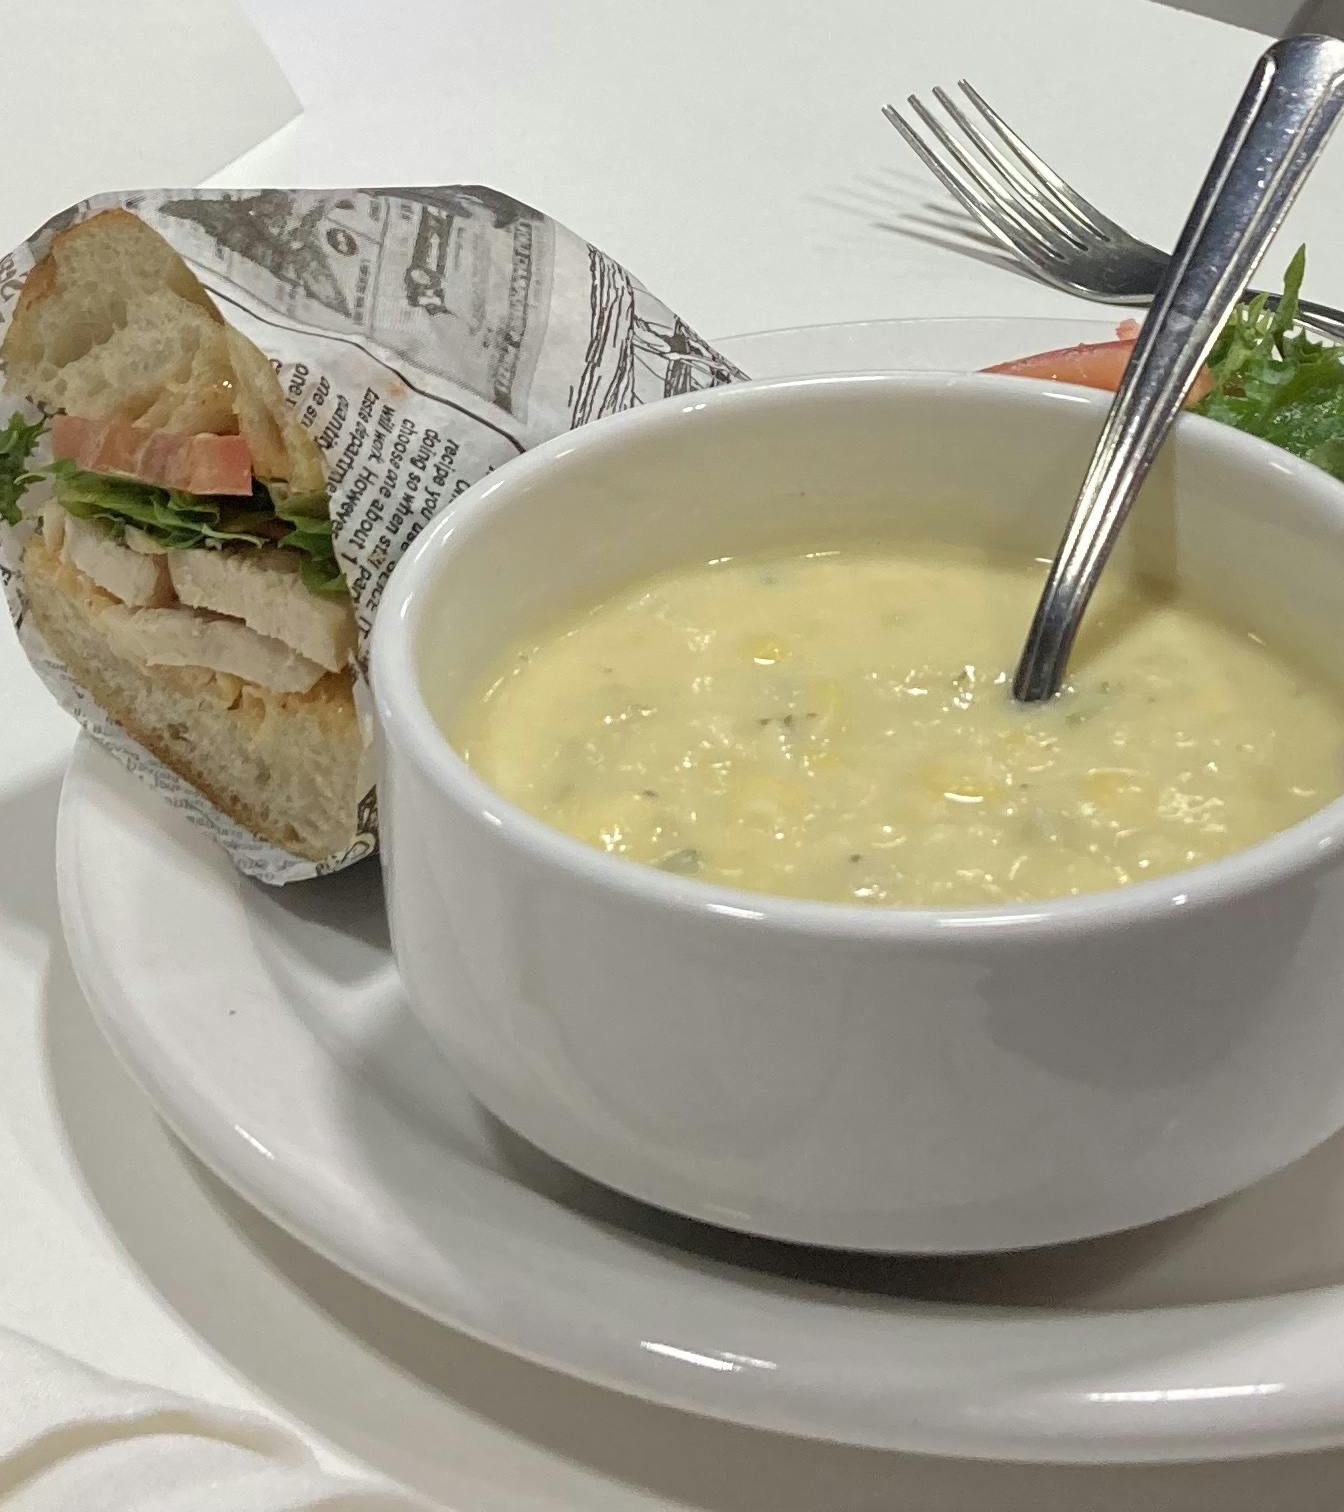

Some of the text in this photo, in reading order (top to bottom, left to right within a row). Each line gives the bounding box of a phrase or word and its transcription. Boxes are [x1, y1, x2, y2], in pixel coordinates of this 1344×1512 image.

[294, 364, 309, 398] one
[358, 387, 379, 424] taste
[378, 404, 395, 430] will
[389, 418, 415, 472] choose
[411, 428, 438, 471] doing
[432, 439, 459, 487] recipe
[406, 471, 421, 493] so
[385, 493, 415, 535] when
[422, 484, 441, 521] you
[356, 498, 386, 550] about
